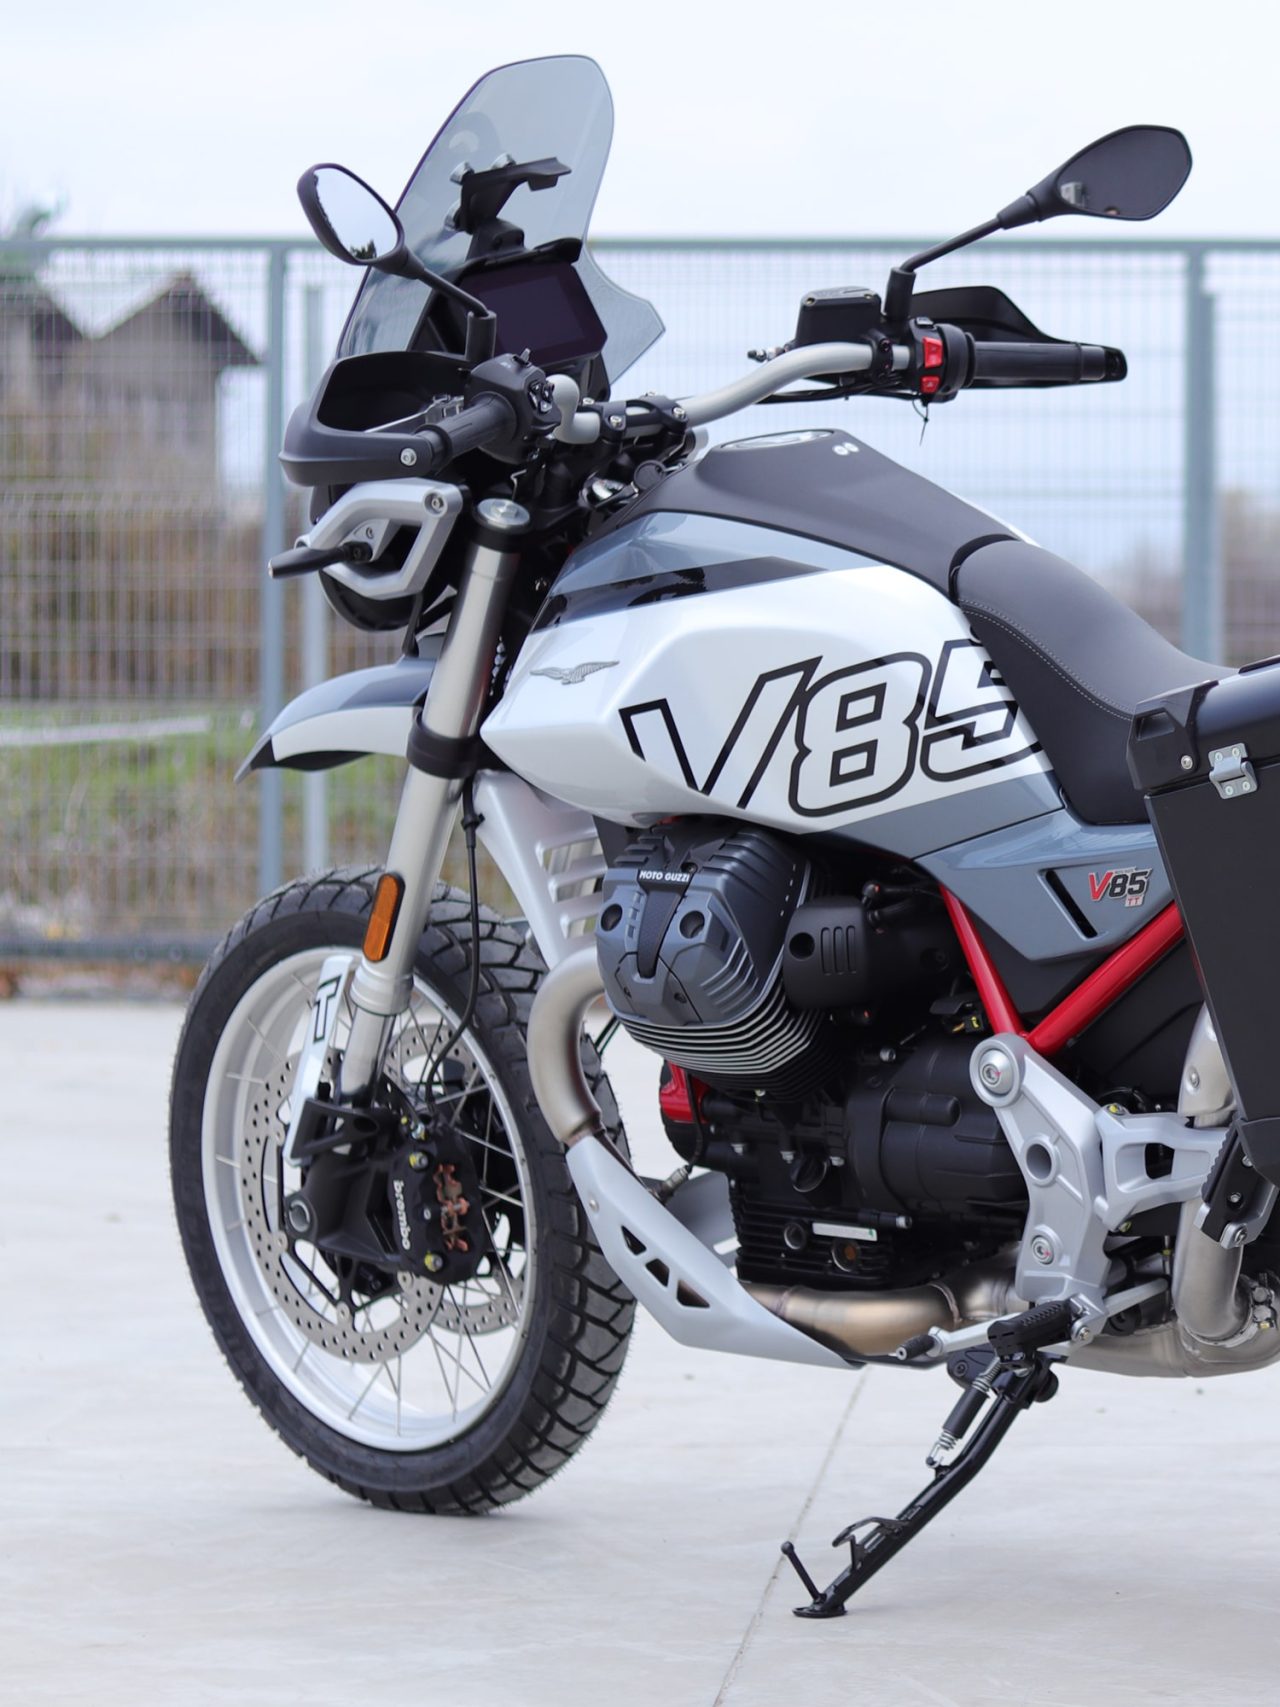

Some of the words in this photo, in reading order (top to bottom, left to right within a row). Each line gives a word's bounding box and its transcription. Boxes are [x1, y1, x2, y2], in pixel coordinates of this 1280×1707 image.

[618, 639, 1044, 816] V85
[639, 870, 663, 881] MOTO
[664, 872, 691, 883] GUZZI
[1089, 870, 1150, 900] V85
[1127, 897, 1140, 906] TT
[393, 1180, 411, 1250] brembo
